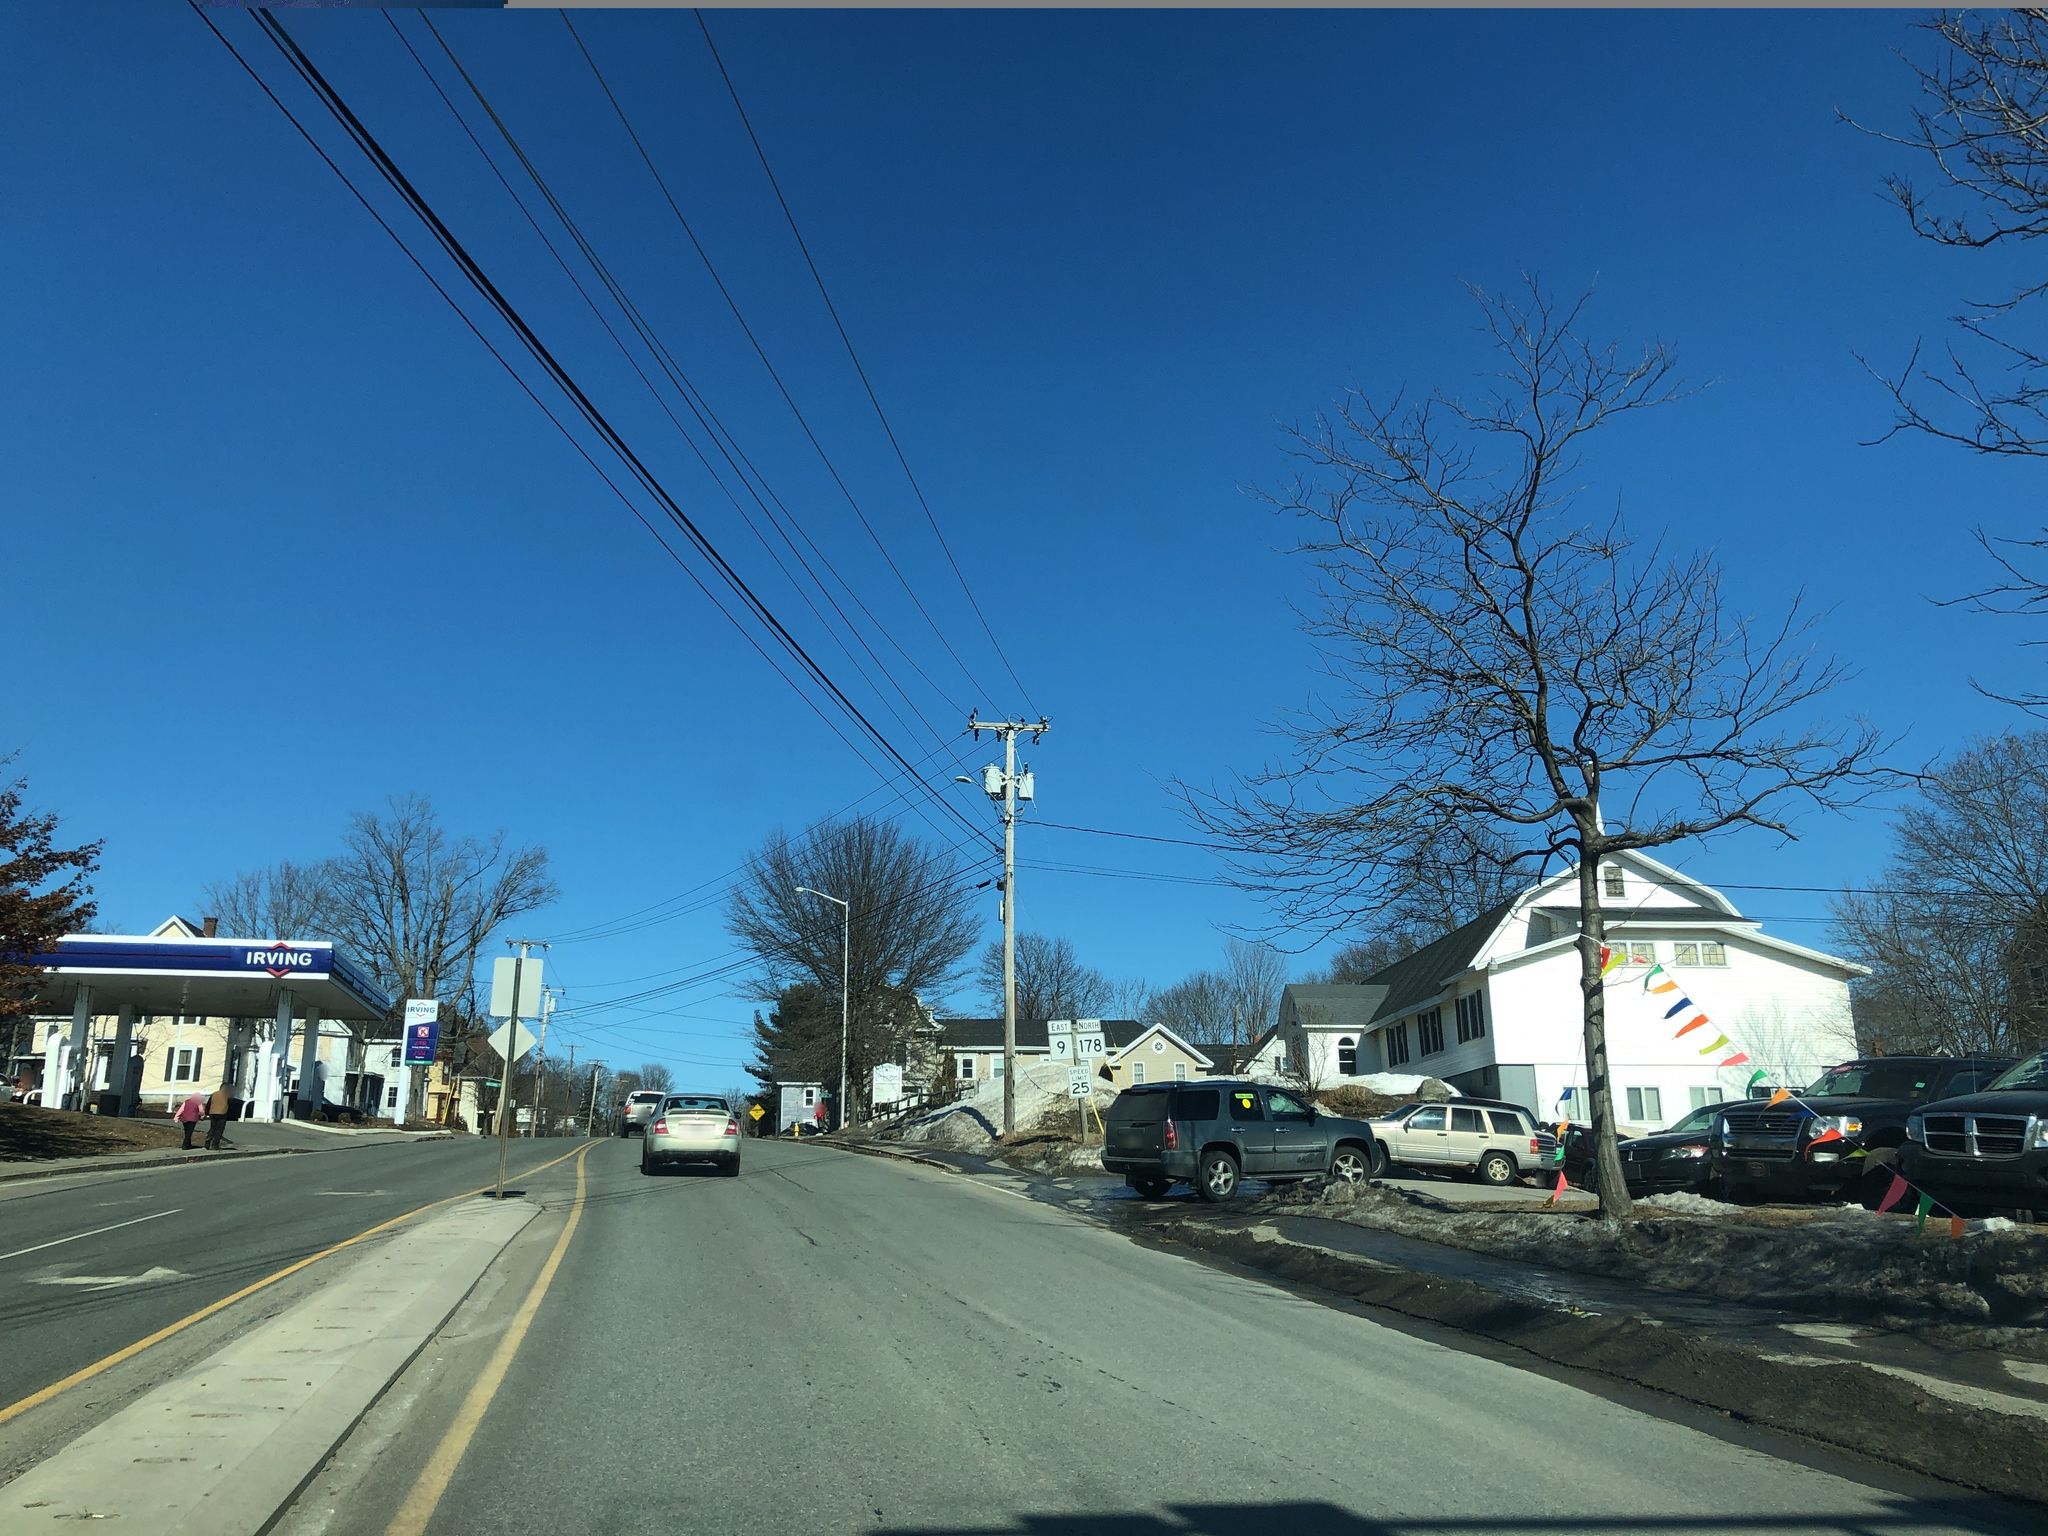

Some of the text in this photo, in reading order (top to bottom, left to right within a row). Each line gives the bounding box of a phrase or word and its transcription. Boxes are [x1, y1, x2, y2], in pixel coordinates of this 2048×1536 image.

[246, 951, 312, 966] IRVING
[407, 1006, 436, 1014] IRVING
[1052, 1023, 1068, 1032] EAST
[1078, 1022, 1099, 1030] NORTH
[1056, 1040, 1066, 1054] 9
[1079, 1038, 1102, 1053] 178
[1072, 1082, 1090, 1094] 25
